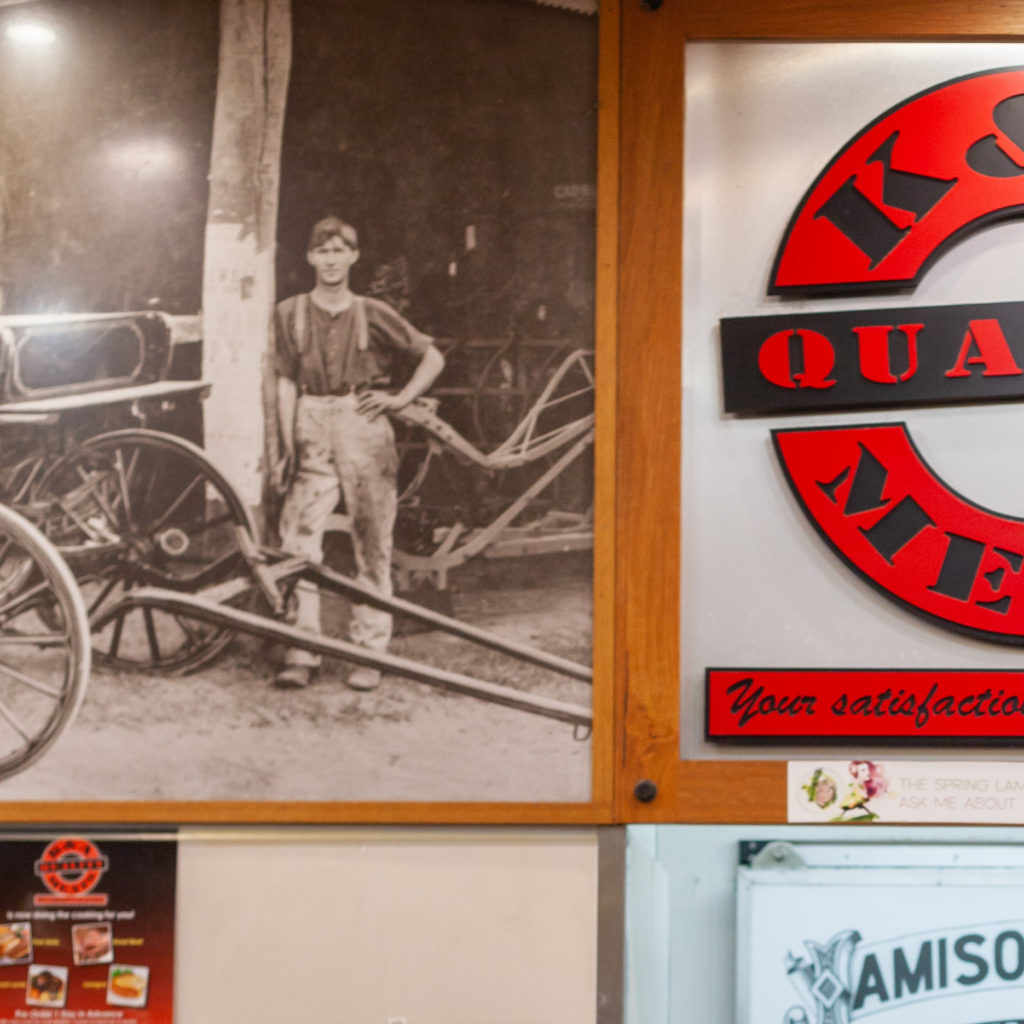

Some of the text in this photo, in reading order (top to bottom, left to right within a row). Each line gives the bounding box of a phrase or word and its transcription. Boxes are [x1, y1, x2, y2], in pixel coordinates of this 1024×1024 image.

[725, 676, 817, 727] Your
[900, 778, 928, 792] THE
[934, 778, 988, 793] SPRING
[900, 796, 928, 809] ASK
[934, 797, 957, 810] ME
[965, 797, 1016, 810] ABOUT
